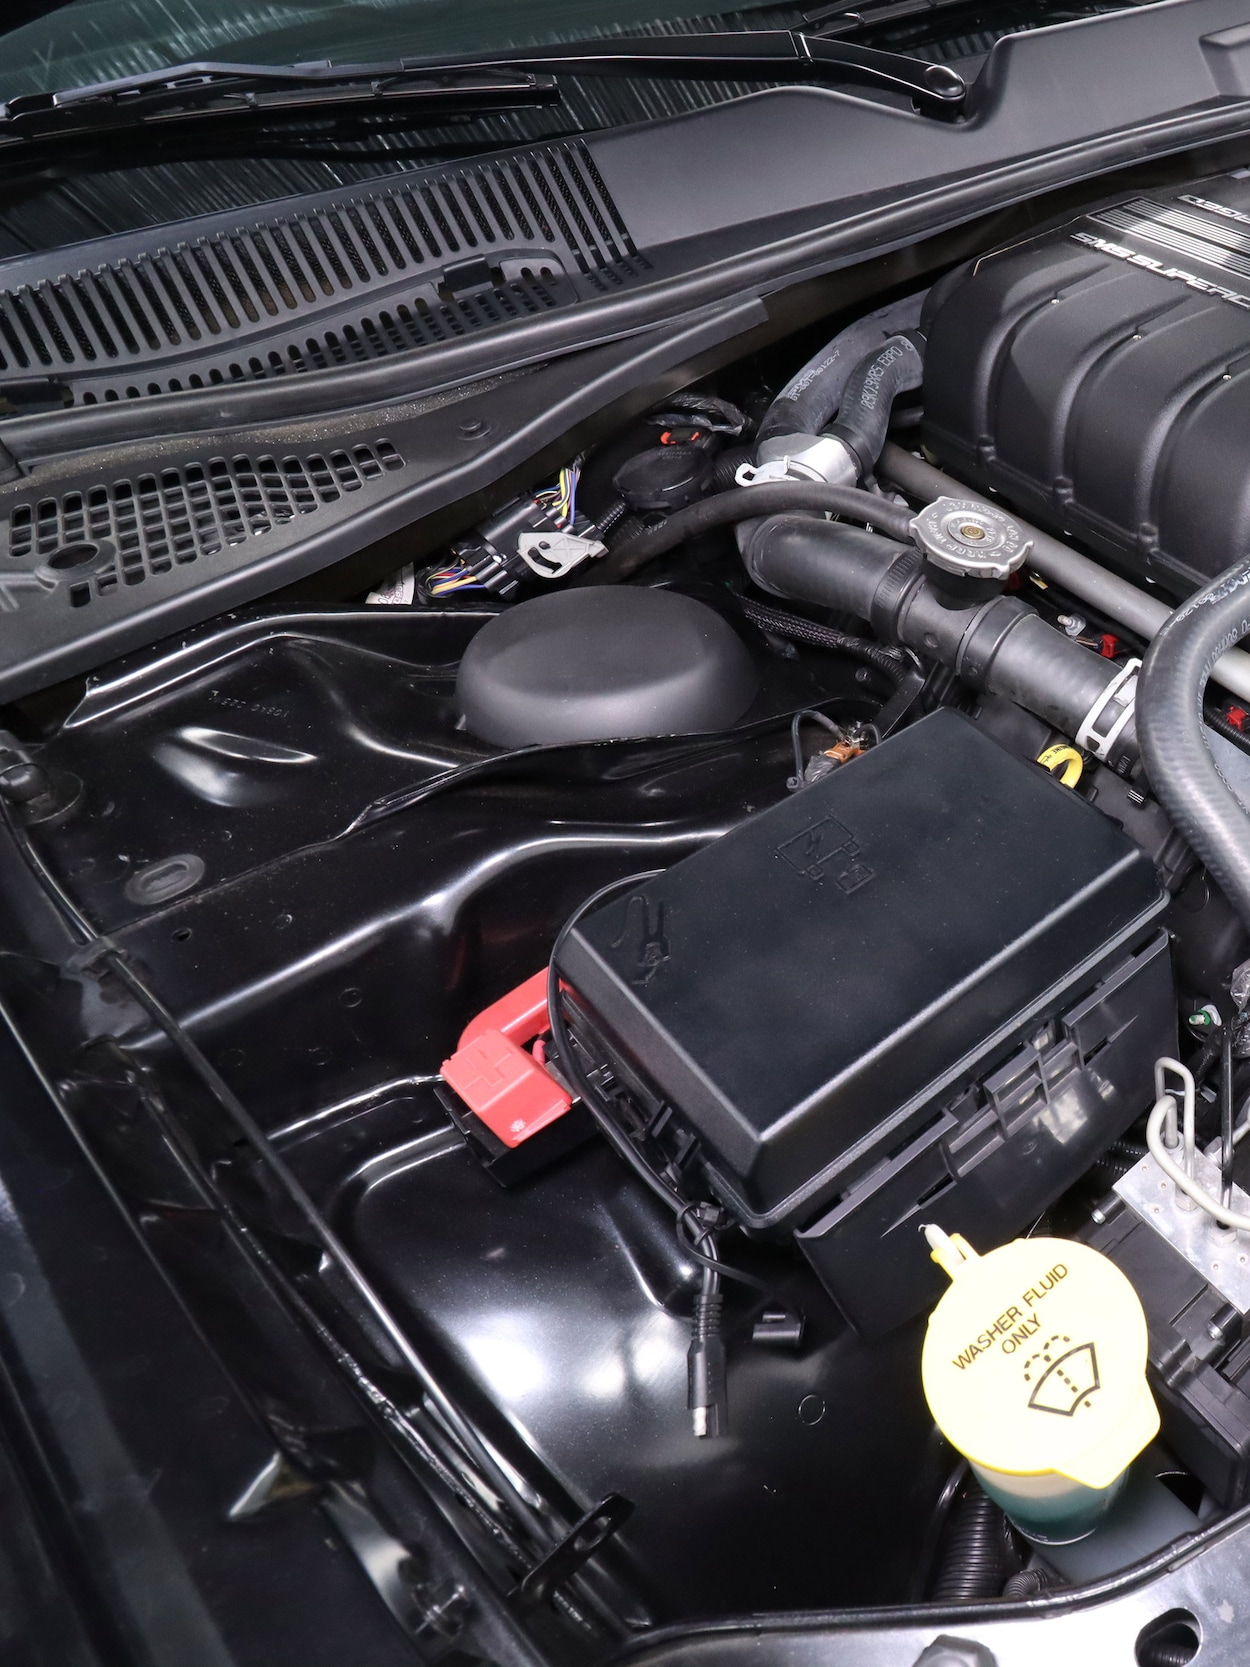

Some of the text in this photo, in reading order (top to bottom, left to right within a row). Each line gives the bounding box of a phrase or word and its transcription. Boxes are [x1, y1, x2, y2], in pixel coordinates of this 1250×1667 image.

[1070, 232, 1136, 260] SMS
[952, 1263, 1068, 1370] WASHER FLUID
[1001, 1313, 1041, 1354] ONLY
